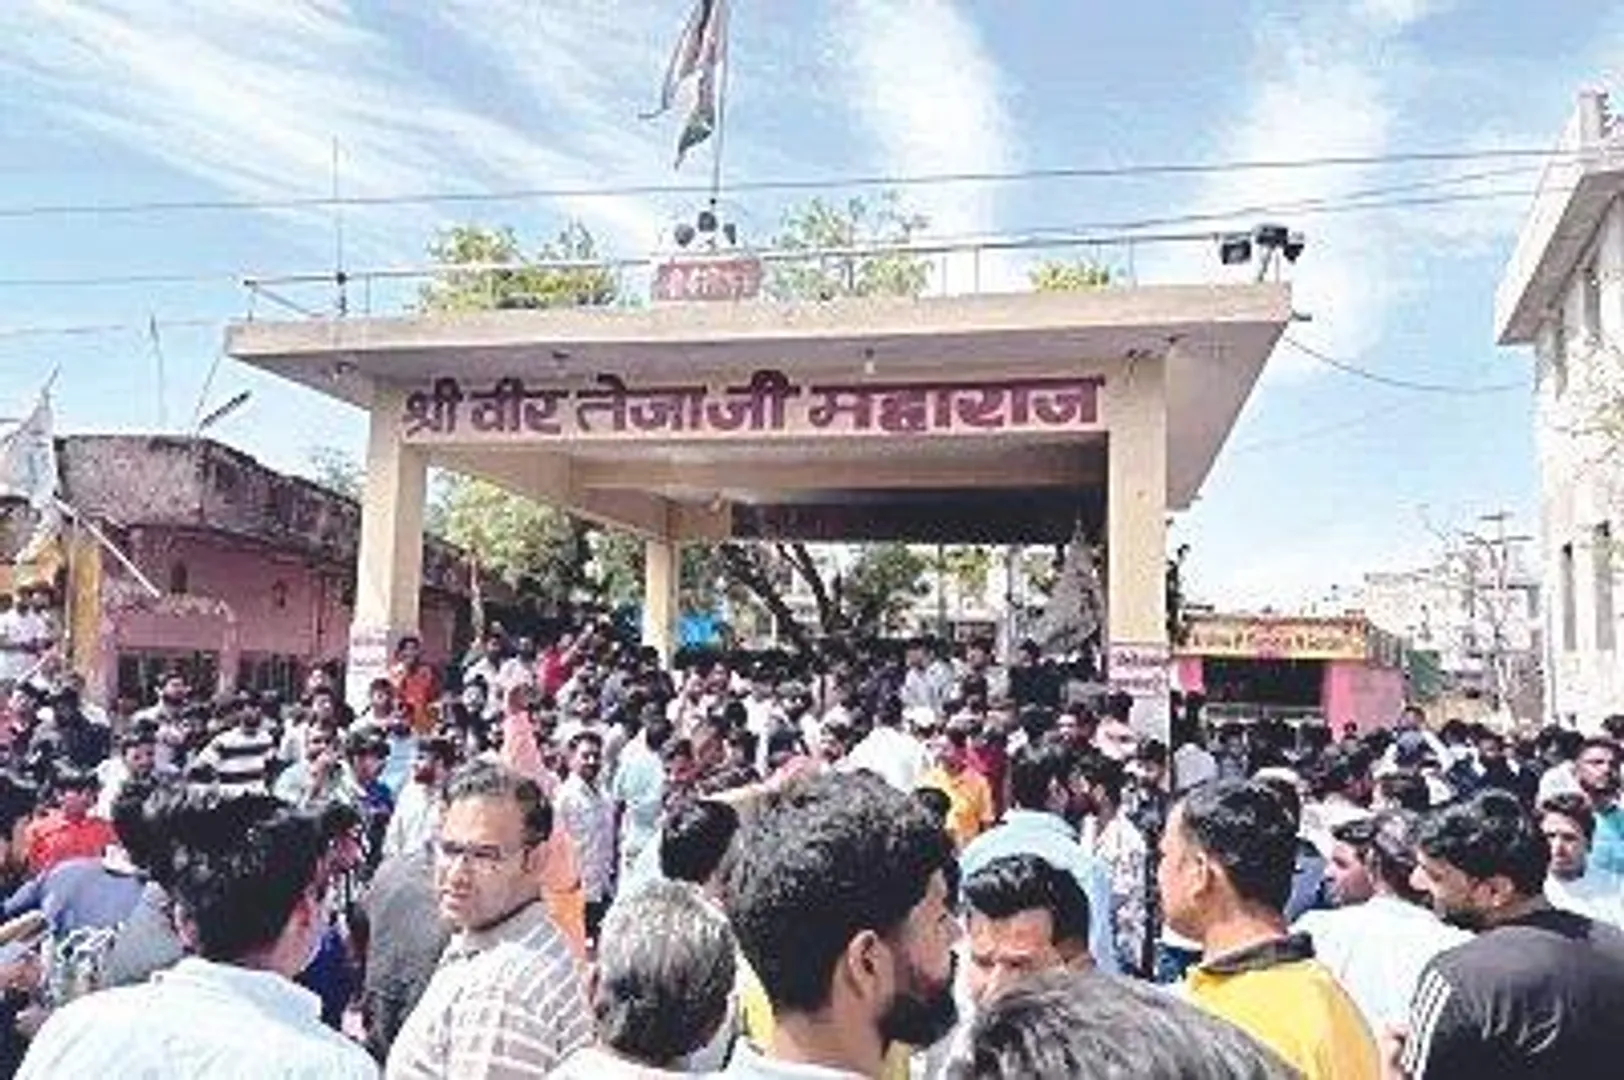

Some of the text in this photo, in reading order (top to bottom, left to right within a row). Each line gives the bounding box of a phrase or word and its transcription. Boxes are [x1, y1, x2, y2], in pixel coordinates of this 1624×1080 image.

[403, 377, 463, 438] श्री
[470, 376, 569, 434] वीर
[808, 374, 1106, 431] महाराज
